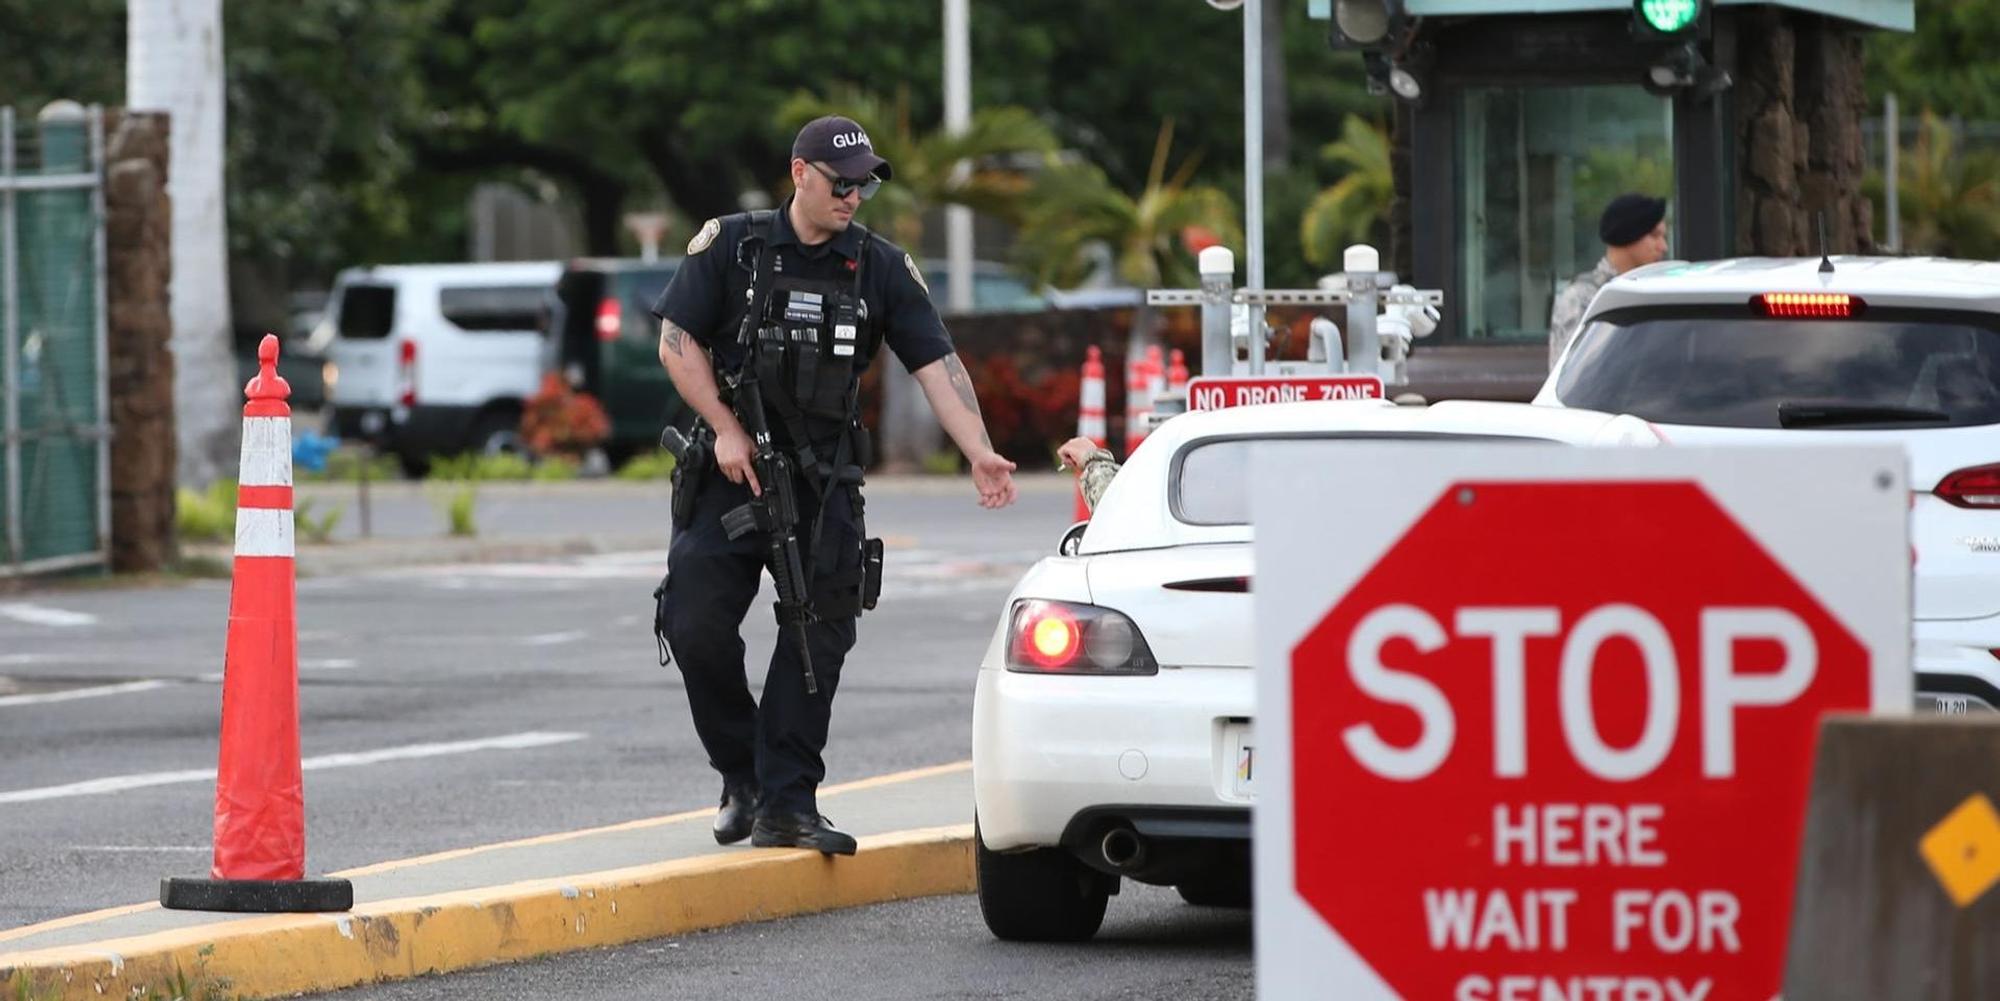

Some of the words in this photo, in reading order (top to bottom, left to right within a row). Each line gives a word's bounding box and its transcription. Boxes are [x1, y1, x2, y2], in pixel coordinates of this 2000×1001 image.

[1195, 387, 1225, 411] NO
[1236, 384, 1308, 406] DRONE
[1319, 383, 1375, 401] ZONE
[1342, 603, 1819, 781] STOP
[1494, 805, 1665, 865] HERE
[1424, 890, 1577, 950] WAIT
[1613, 890, 1740, 951] FOR
